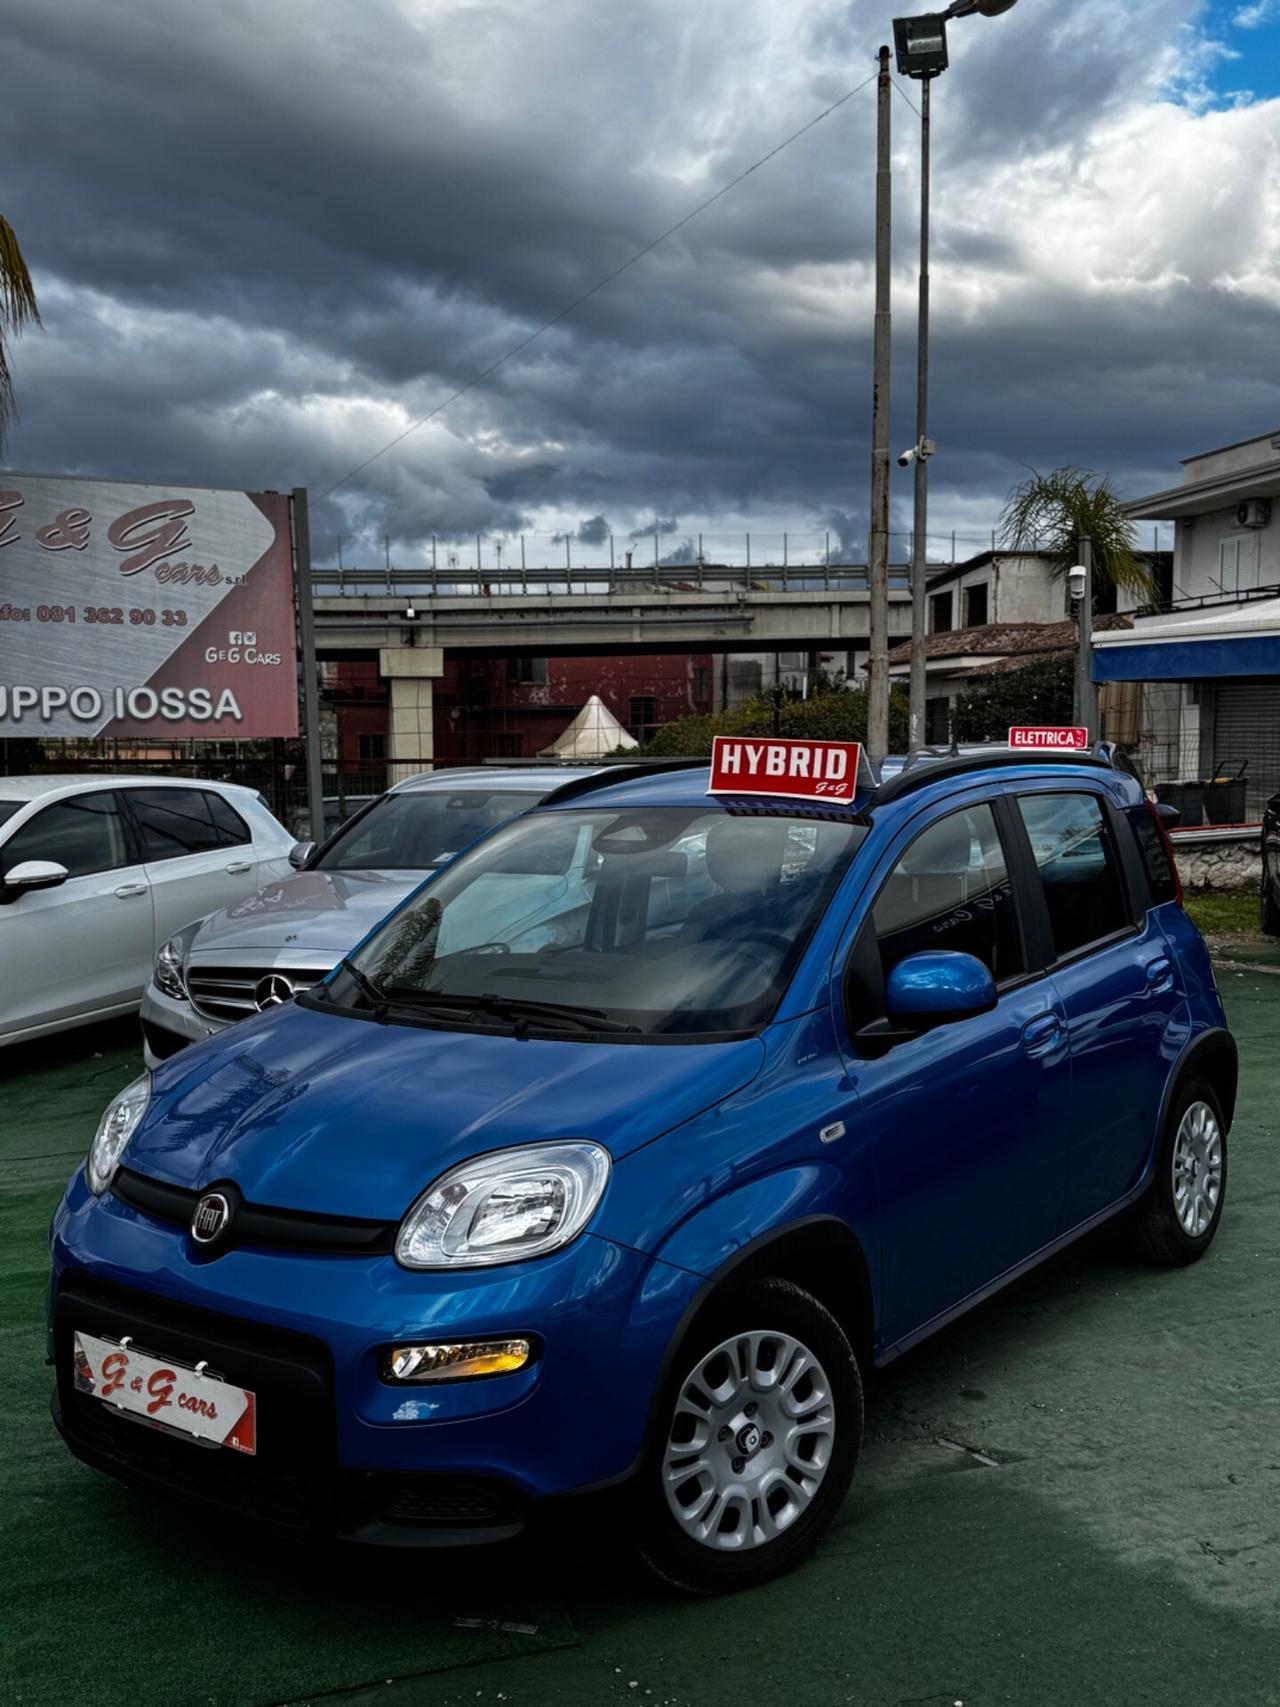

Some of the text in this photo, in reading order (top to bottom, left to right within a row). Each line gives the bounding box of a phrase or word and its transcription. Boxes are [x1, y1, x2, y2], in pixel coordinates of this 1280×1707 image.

[35, 508, 91, 550] &
[107, 499, 195, 576] G
[154, 562, 223, 586] cars
[0, 604, 188, 626] fo: 081 362 90 33
[116, 687, 242, 720] IOSSA
[1014, 731, 1075, 745] ELETTRICA
[720, 744, 848, 780] HYBRID
[198, 1207, 221, 1232] FIAT
[101, 1353, 129, 1397] G
[147, 1369, 177, 1414] G
[178, 1393, 218, 1420] cars
